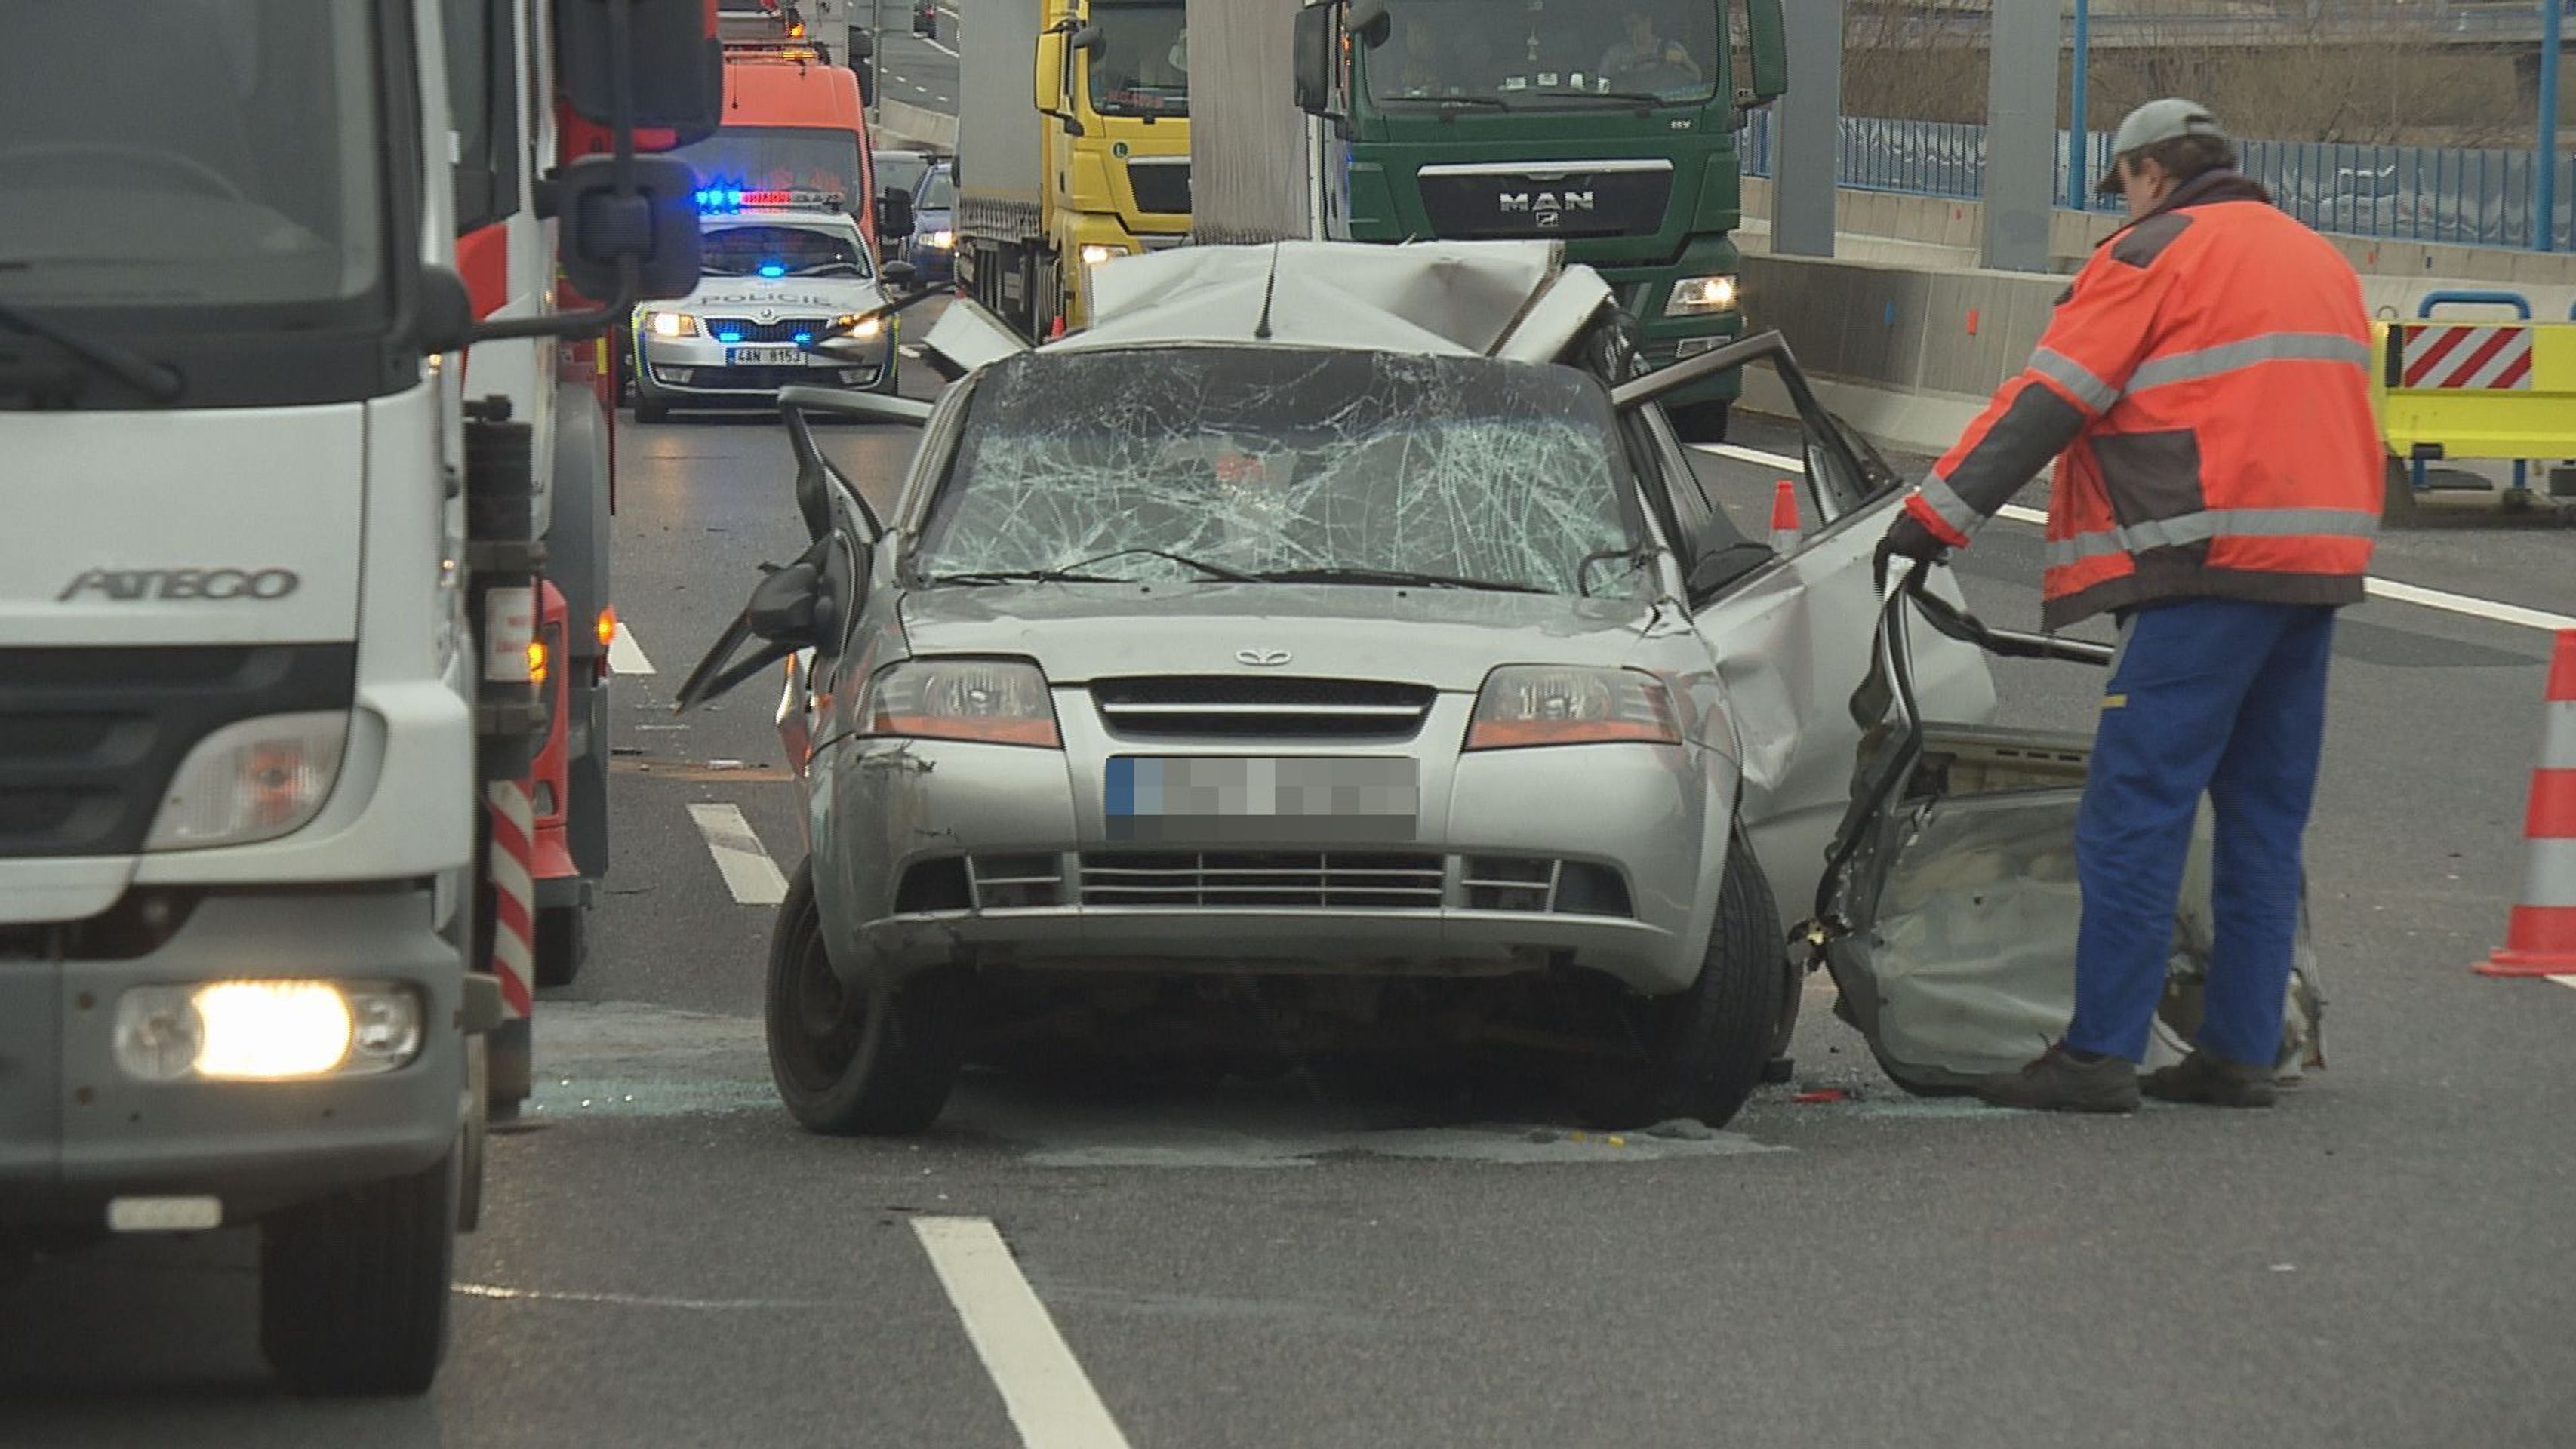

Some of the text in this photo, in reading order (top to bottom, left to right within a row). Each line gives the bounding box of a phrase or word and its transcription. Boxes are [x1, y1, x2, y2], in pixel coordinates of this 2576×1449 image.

[1500, 192, 1594, 211] MAN
[702, 293, 833, 306] POLICIE
[57, 568, 299, 601] ATEGO
